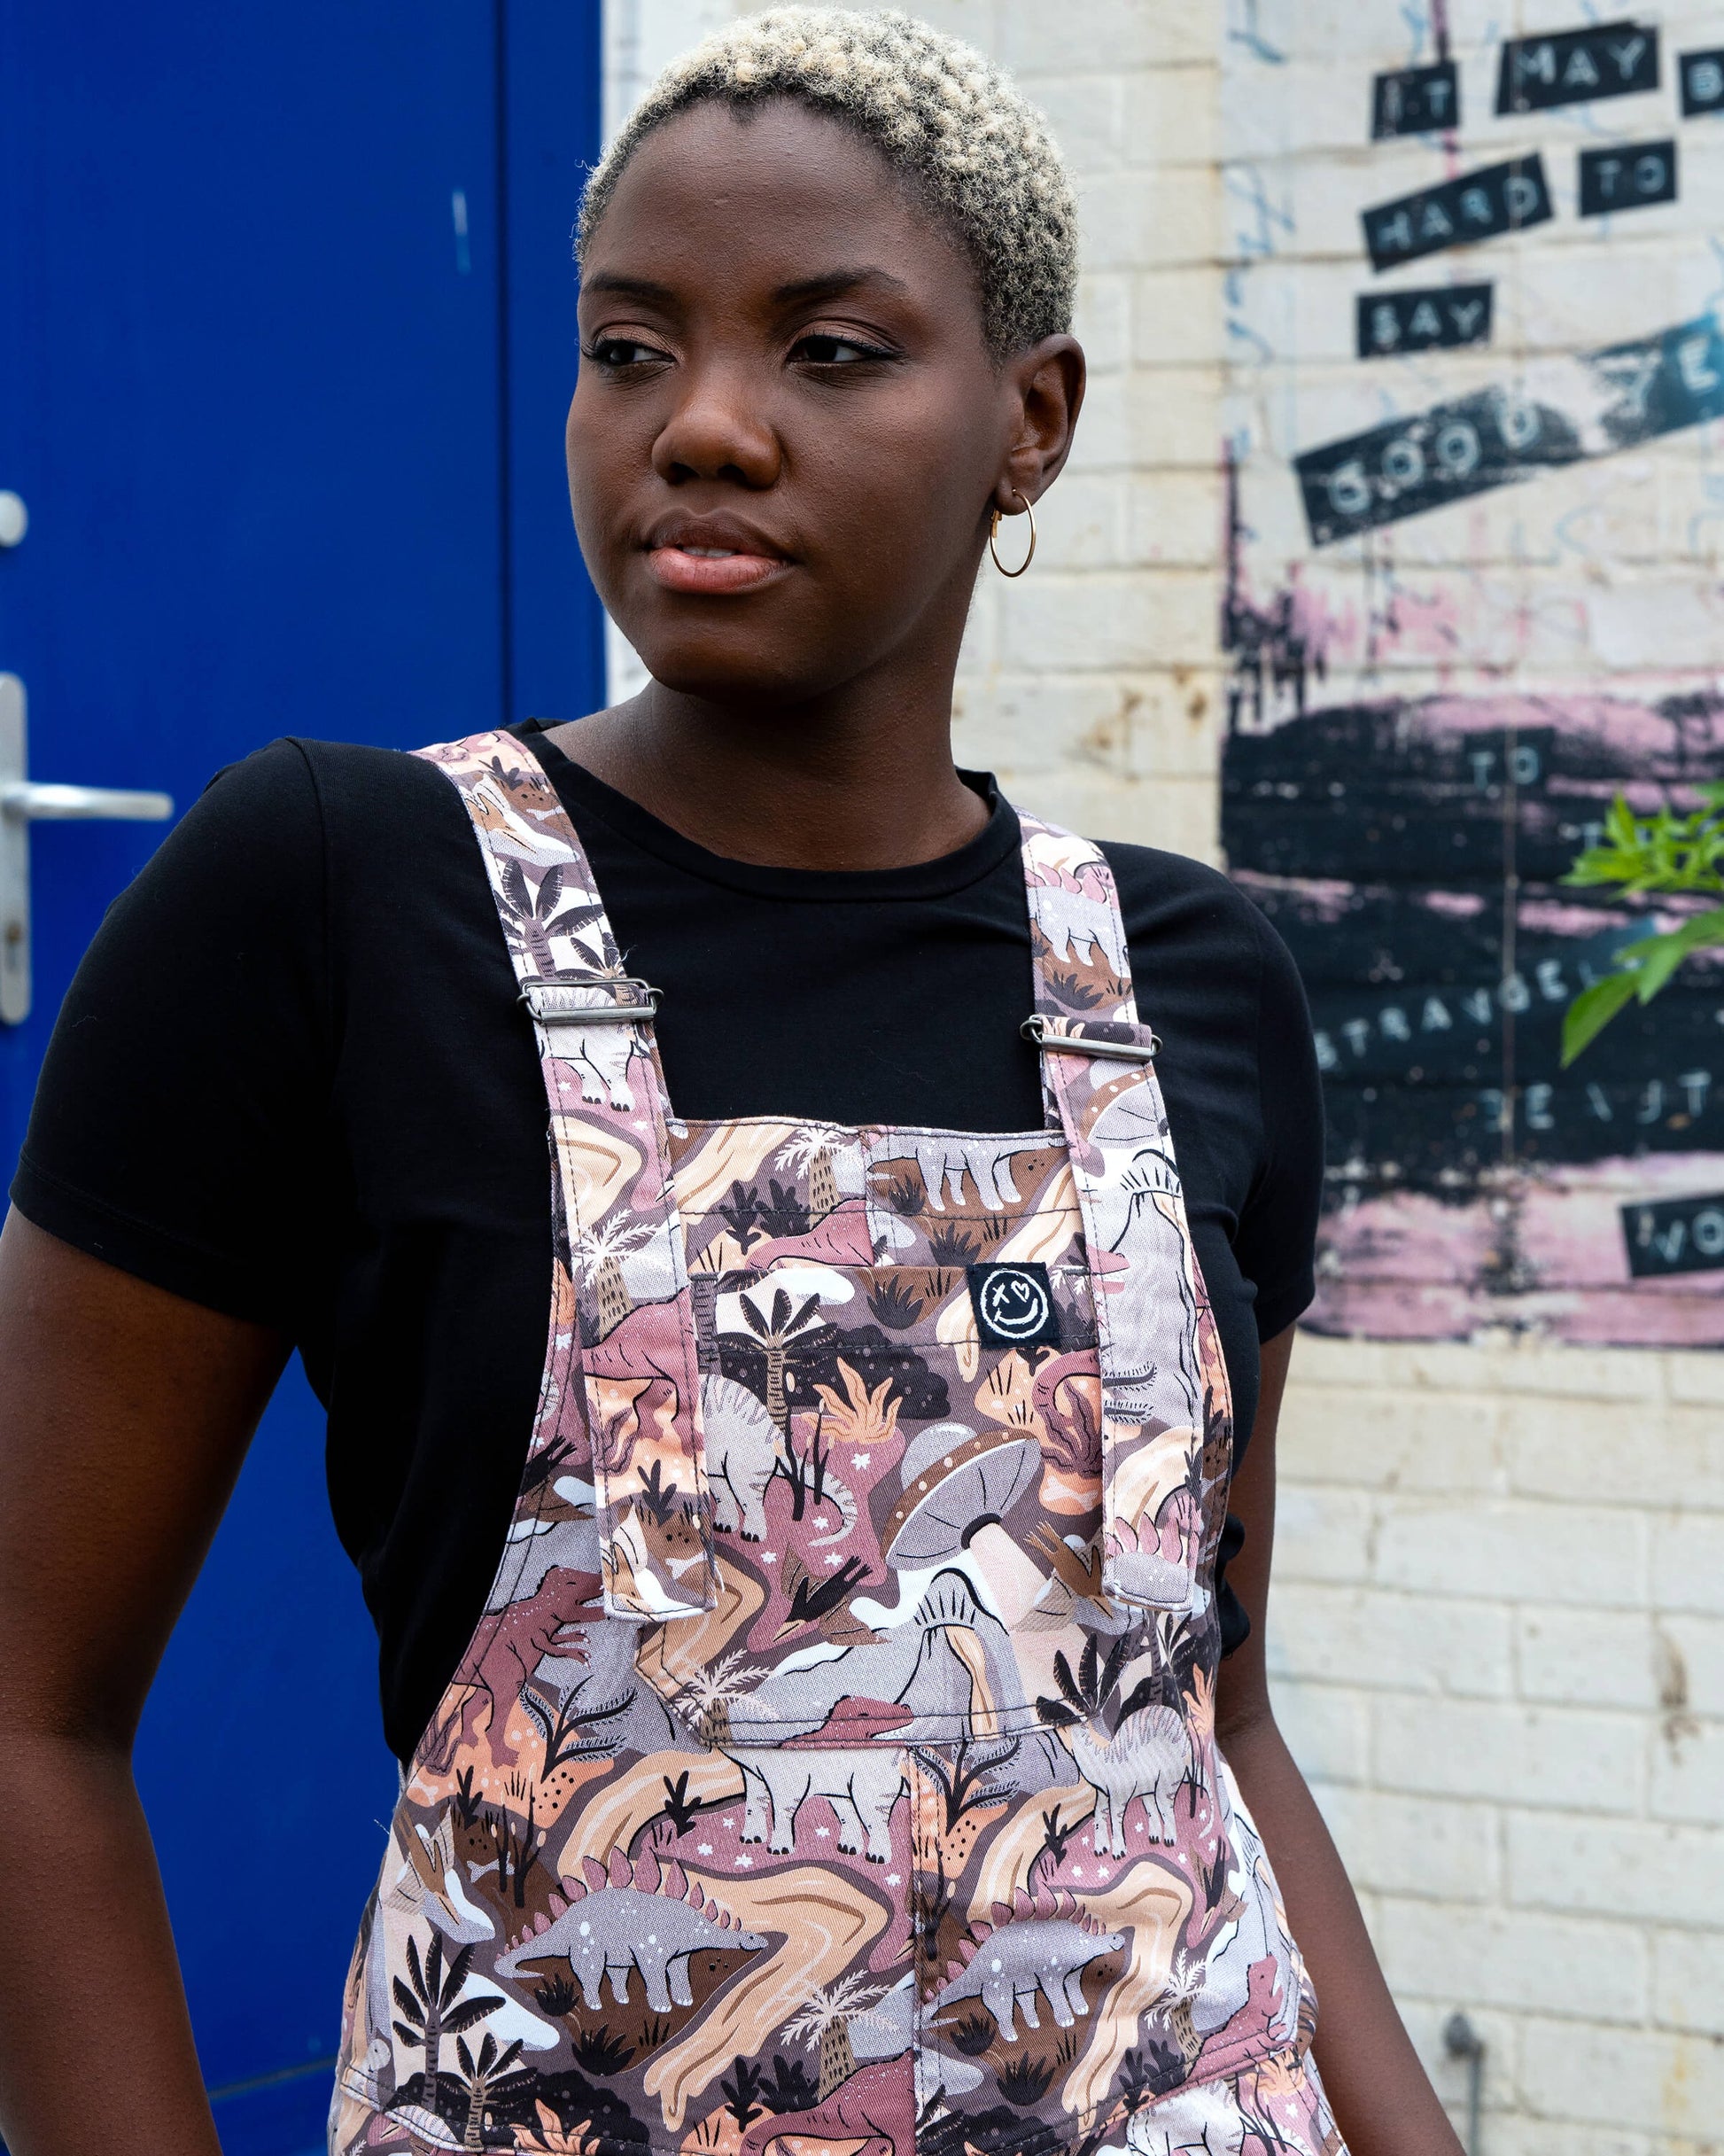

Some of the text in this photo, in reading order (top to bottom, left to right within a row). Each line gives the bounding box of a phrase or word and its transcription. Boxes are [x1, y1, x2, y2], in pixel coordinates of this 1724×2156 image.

[1516, 36, 1648, 86] MAY
[1687, 59, 1724, 102] B
[1375, 153, 1667, 253] HARD TO
[1371, 299, 1485, 346] SAY
[1468, 745, 1540, 791] TO
